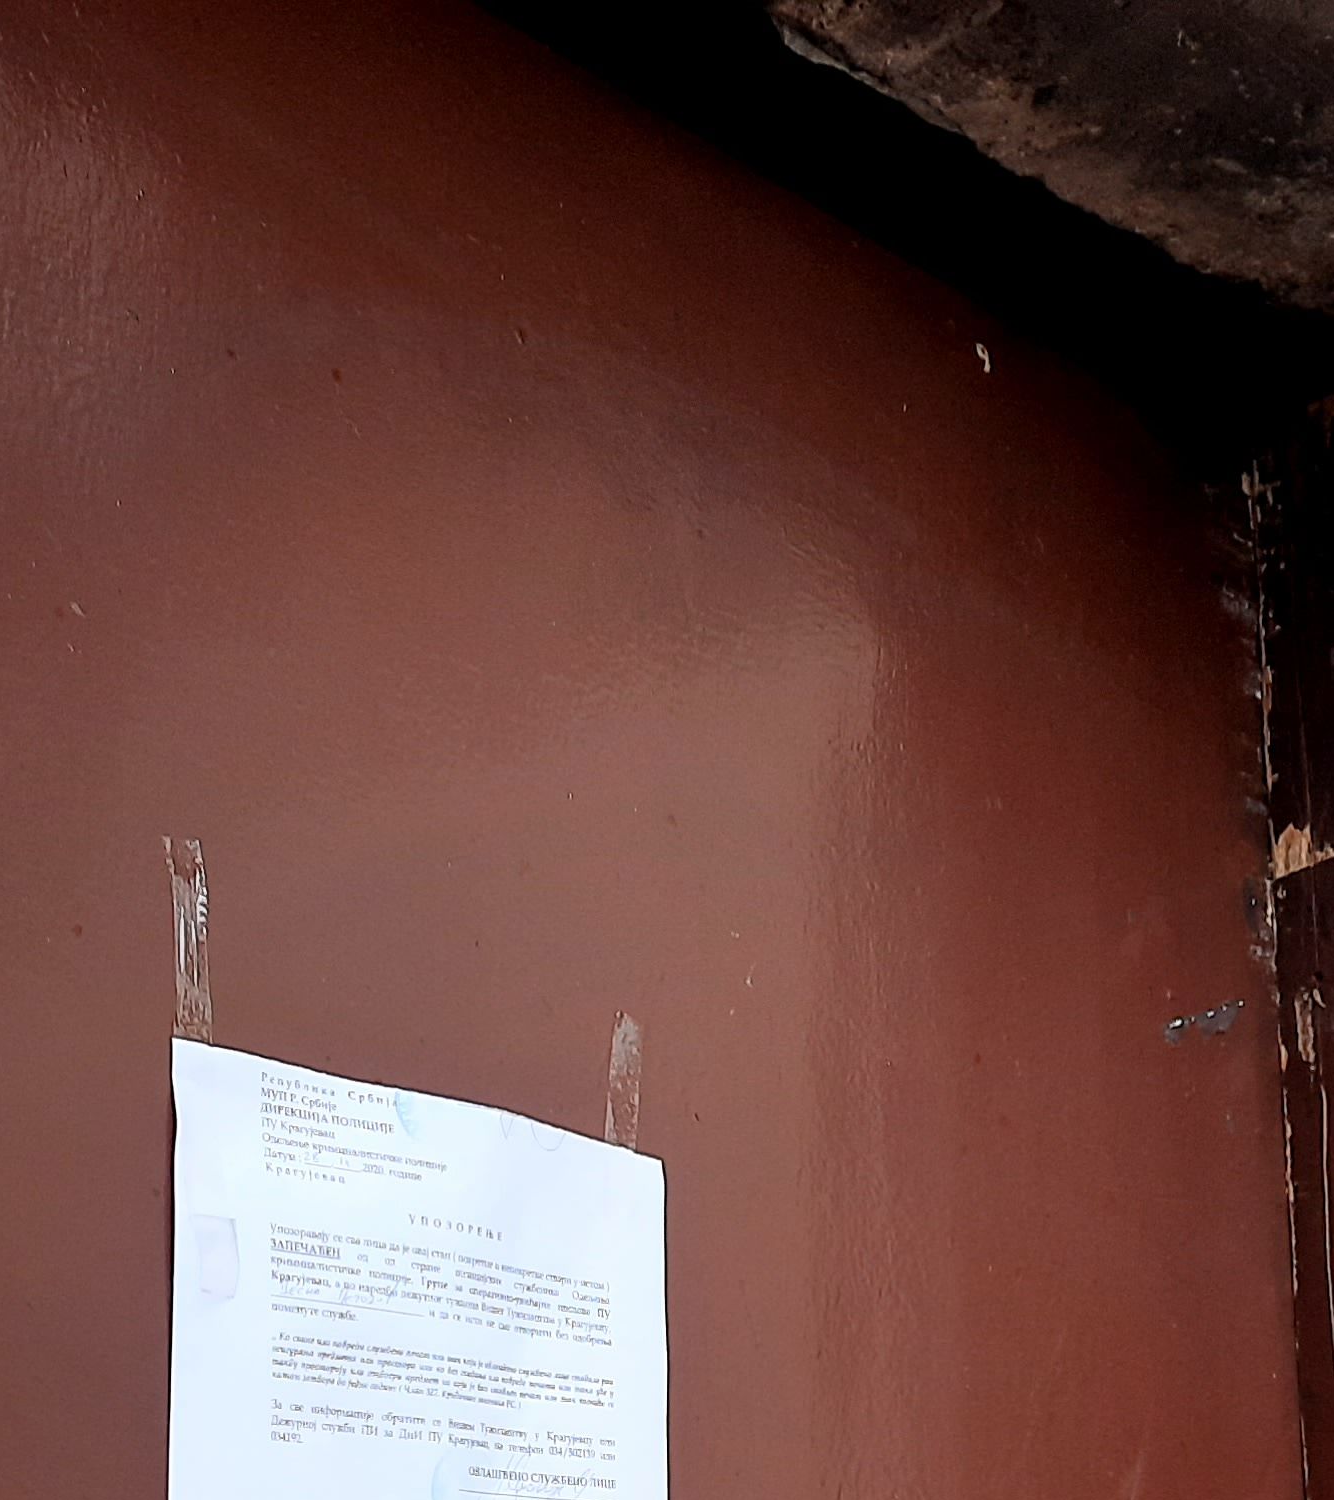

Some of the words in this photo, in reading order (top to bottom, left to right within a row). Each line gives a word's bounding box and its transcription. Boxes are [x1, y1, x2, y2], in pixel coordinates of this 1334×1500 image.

[301, 1095, 337, 1111] Србије
[259, 1102, 327, 1124] ДИРЕКЦИЈА
[331, 1114, 394, 1134] ПОЛИЦИЈЕ
